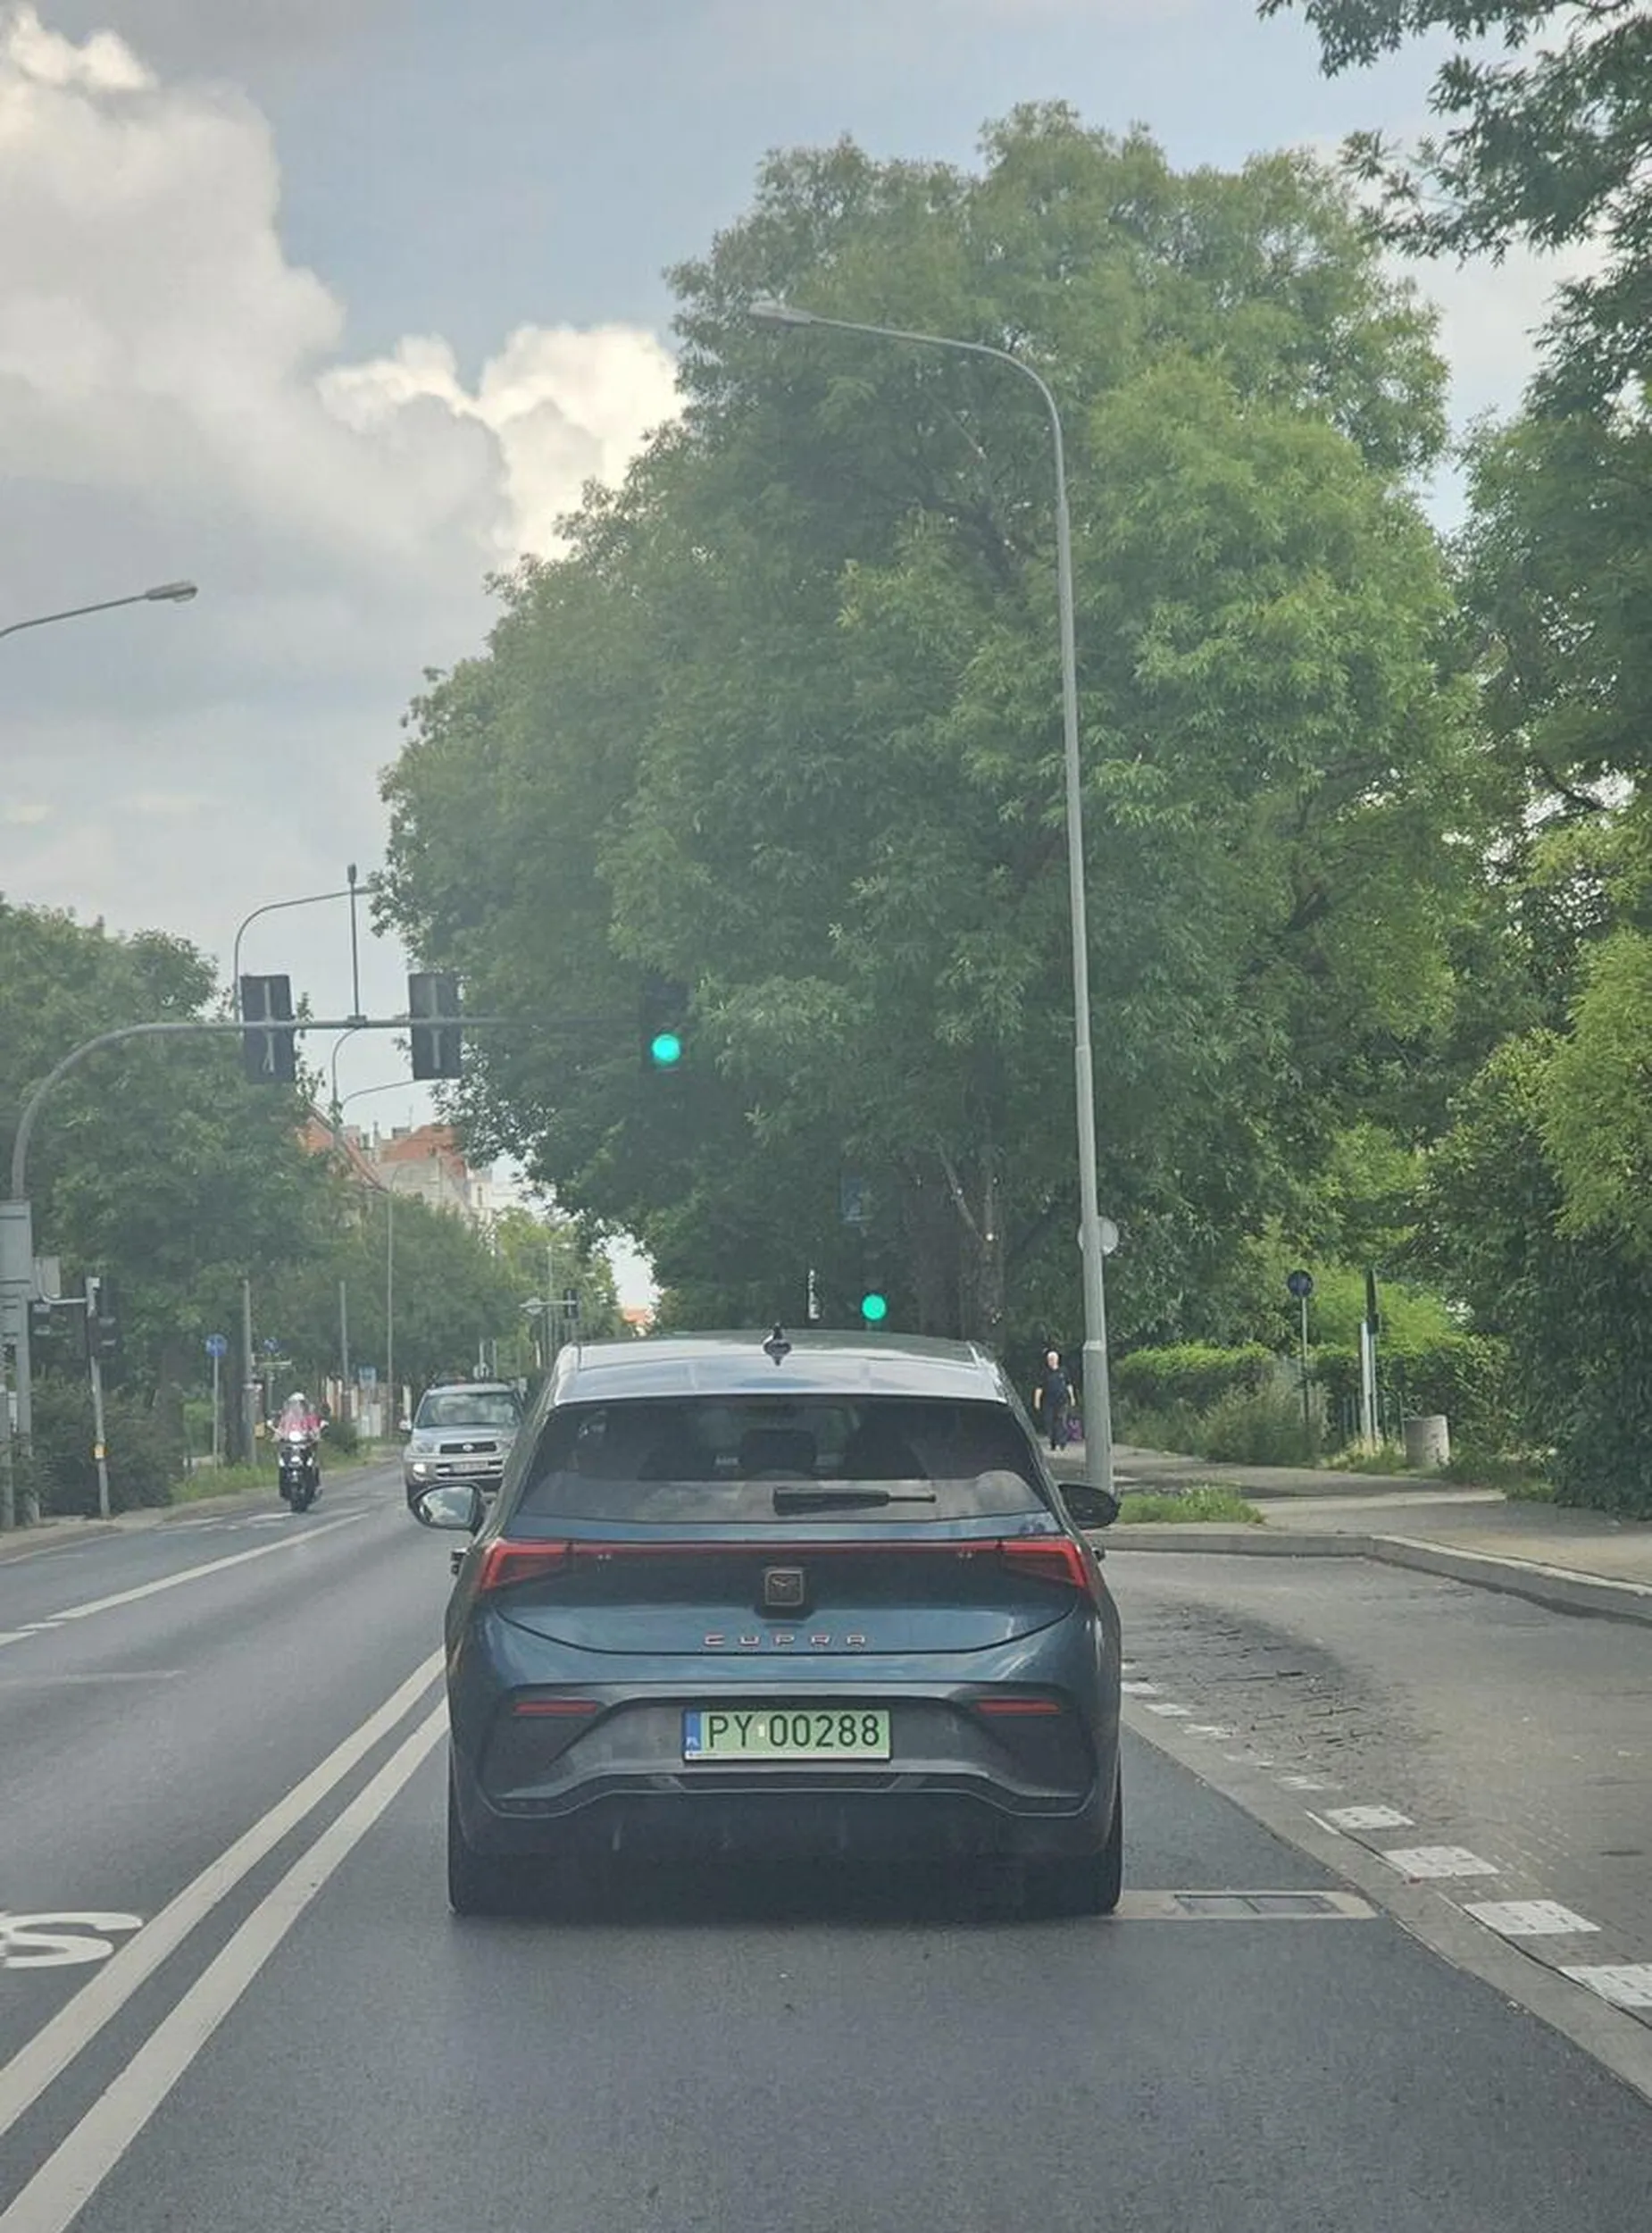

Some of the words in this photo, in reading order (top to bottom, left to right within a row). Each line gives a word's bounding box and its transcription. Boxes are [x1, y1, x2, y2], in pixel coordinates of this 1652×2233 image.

[704, 1633, 866, 1646] CUPRA
[709, 1715, 753, 1748] PY
[769, 1714, 880, 1747] 00288
